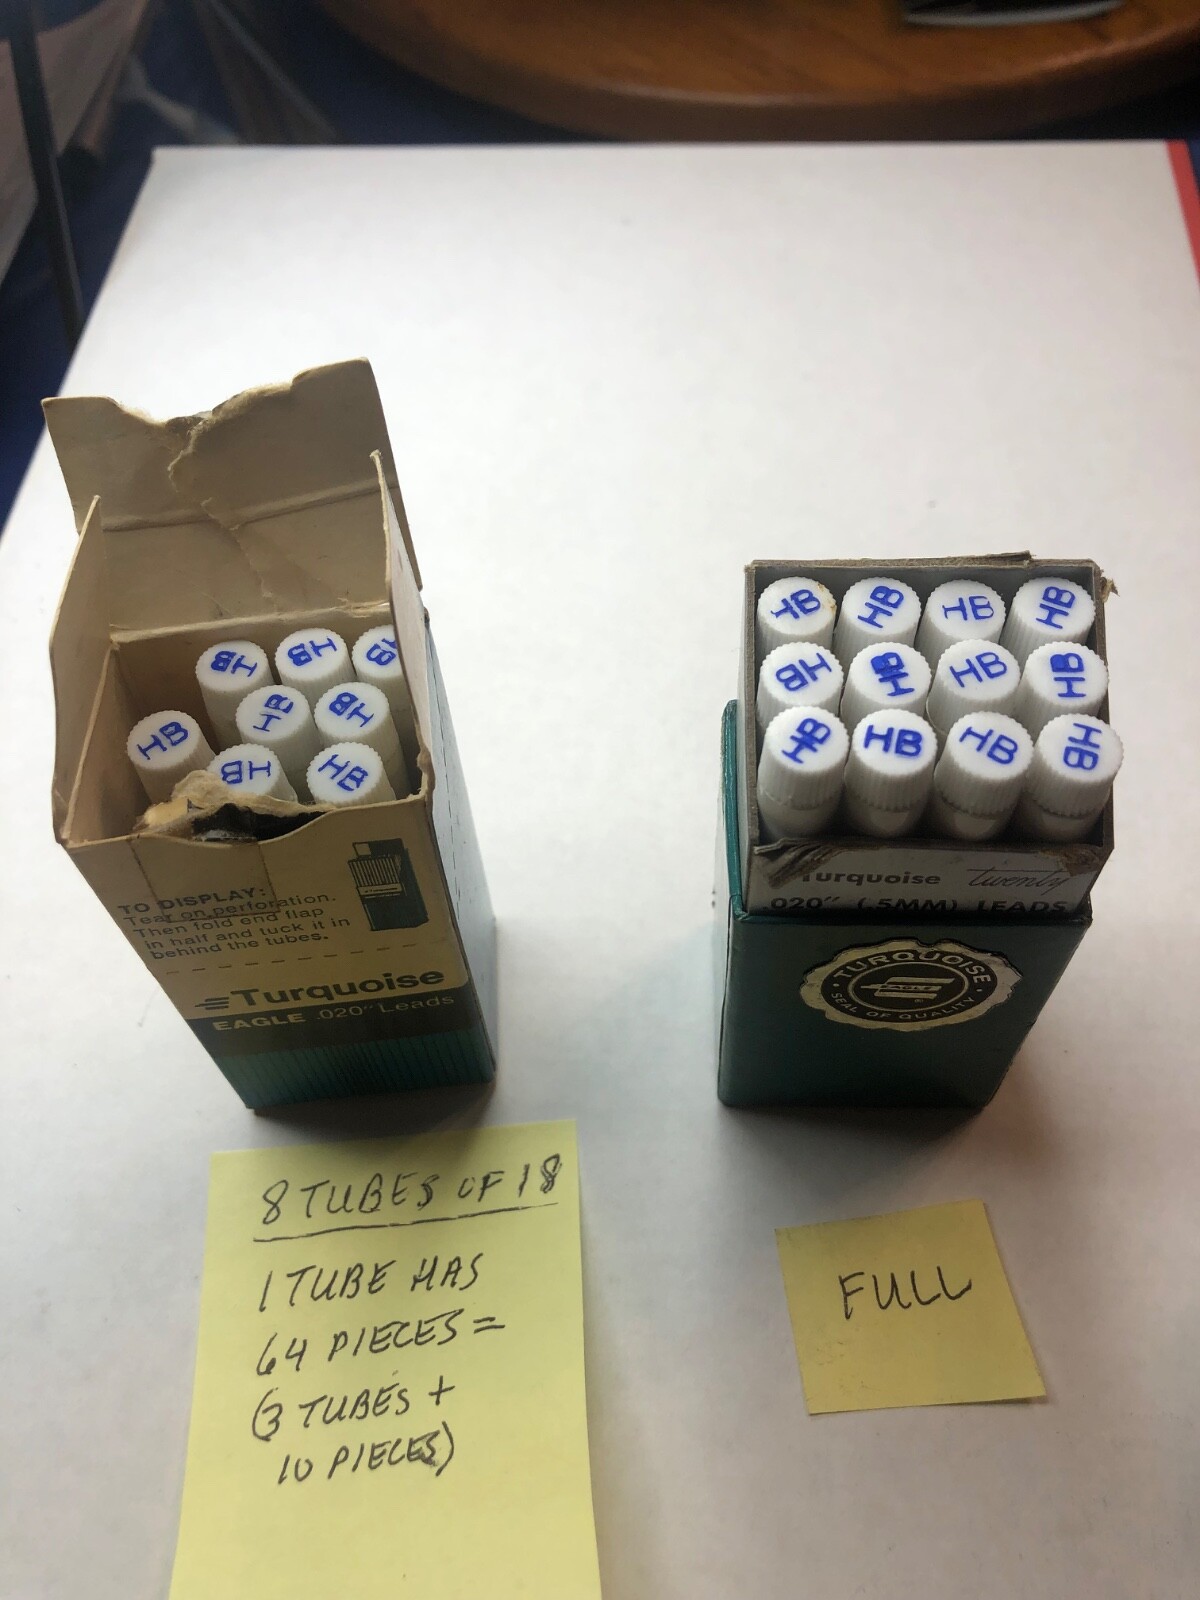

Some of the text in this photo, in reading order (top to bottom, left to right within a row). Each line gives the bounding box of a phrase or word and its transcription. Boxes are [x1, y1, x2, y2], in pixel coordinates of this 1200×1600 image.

[770, 589, 821, 620] HB
[858, 585, 905, 629] HB
[942, 595, 995, 621] HB
[1035, 586, 1076, 630] HB
[210, 650, 258, 677] HB
[287, 637, 338, 667] HB
[949, 651, 1008, 688] HB
[775, 653, 832, 692] HB
[870, 652, 915, 697] HB
[1050, 652, 1086, 699] HB
[253, 693, 294, 732] HB
[328, 691, 375, 728] HB
[138, 721, 189, 760] HB
[782, 718, 832, 765] HB
[863, 724, 924, 759] HB
[959, 726, 1019, 766] HB
[1063, 722, 1103, 771] HB
[221, 759, 272, 785] HB
[318, 754, 369, 792] HB
[118, 887, 266, 915] TO DISPLAY:
[123, 893, 337, 927] Tear on perforation.
[976, 899, 1068, 912] LEADS
[133, 907, 324, 938] Then fold end flap
[143, 916, 351, 951] in half and tuck it in
[150, 932, 329, 960] behind the tubes.
[833, 951, 992, 984] TURQUOISE
[230, 970, 445, 1006] Turquoise
[831, 992, 976, 1020] SEAL OF QUALITY
[212, 1012, 306, 1031] EAGLE
[378, 995, 455, 1014] Leads
[261, 1153, 563, 1225] 8 TUBES OF 18
[258, 1252, 485, 1312] 1 TUBE HAS
[838, 1265, 972, 1320] FULL
[255, 1331, 308, 1377] 64
[327, 1307, 466, 1363] PIECES
[298, 1382, 411, 1430] TUBES
[277, 1420, 455, 1486] 10 PIECES)
